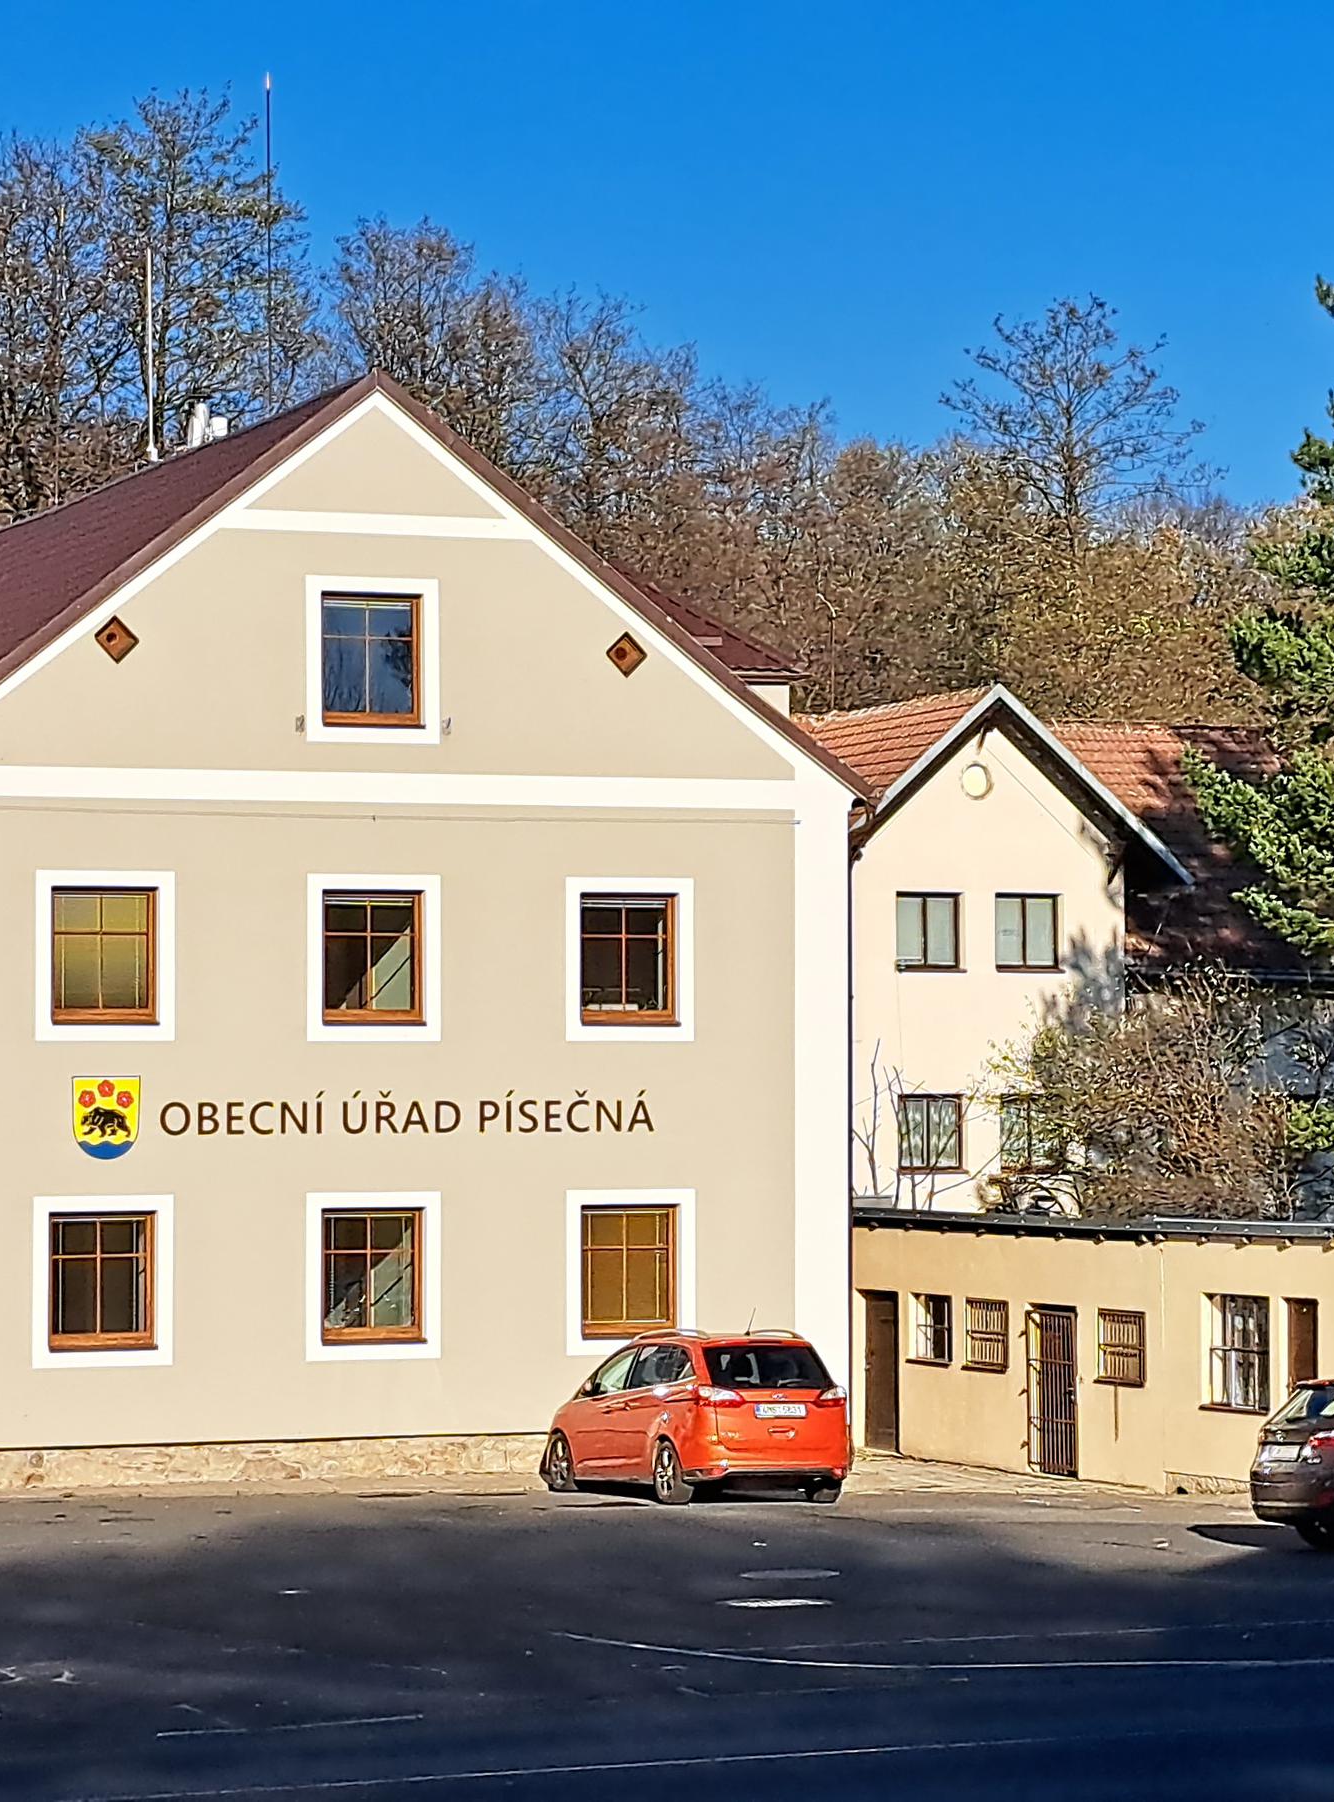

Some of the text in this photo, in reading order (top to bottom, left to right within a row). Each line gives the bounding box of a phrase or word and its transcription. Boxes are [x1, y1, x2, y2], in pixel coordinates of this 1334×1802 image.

[159, 1089, 655, 1136] OBECNÍ ÚŘAD PÍSEČNÁ
